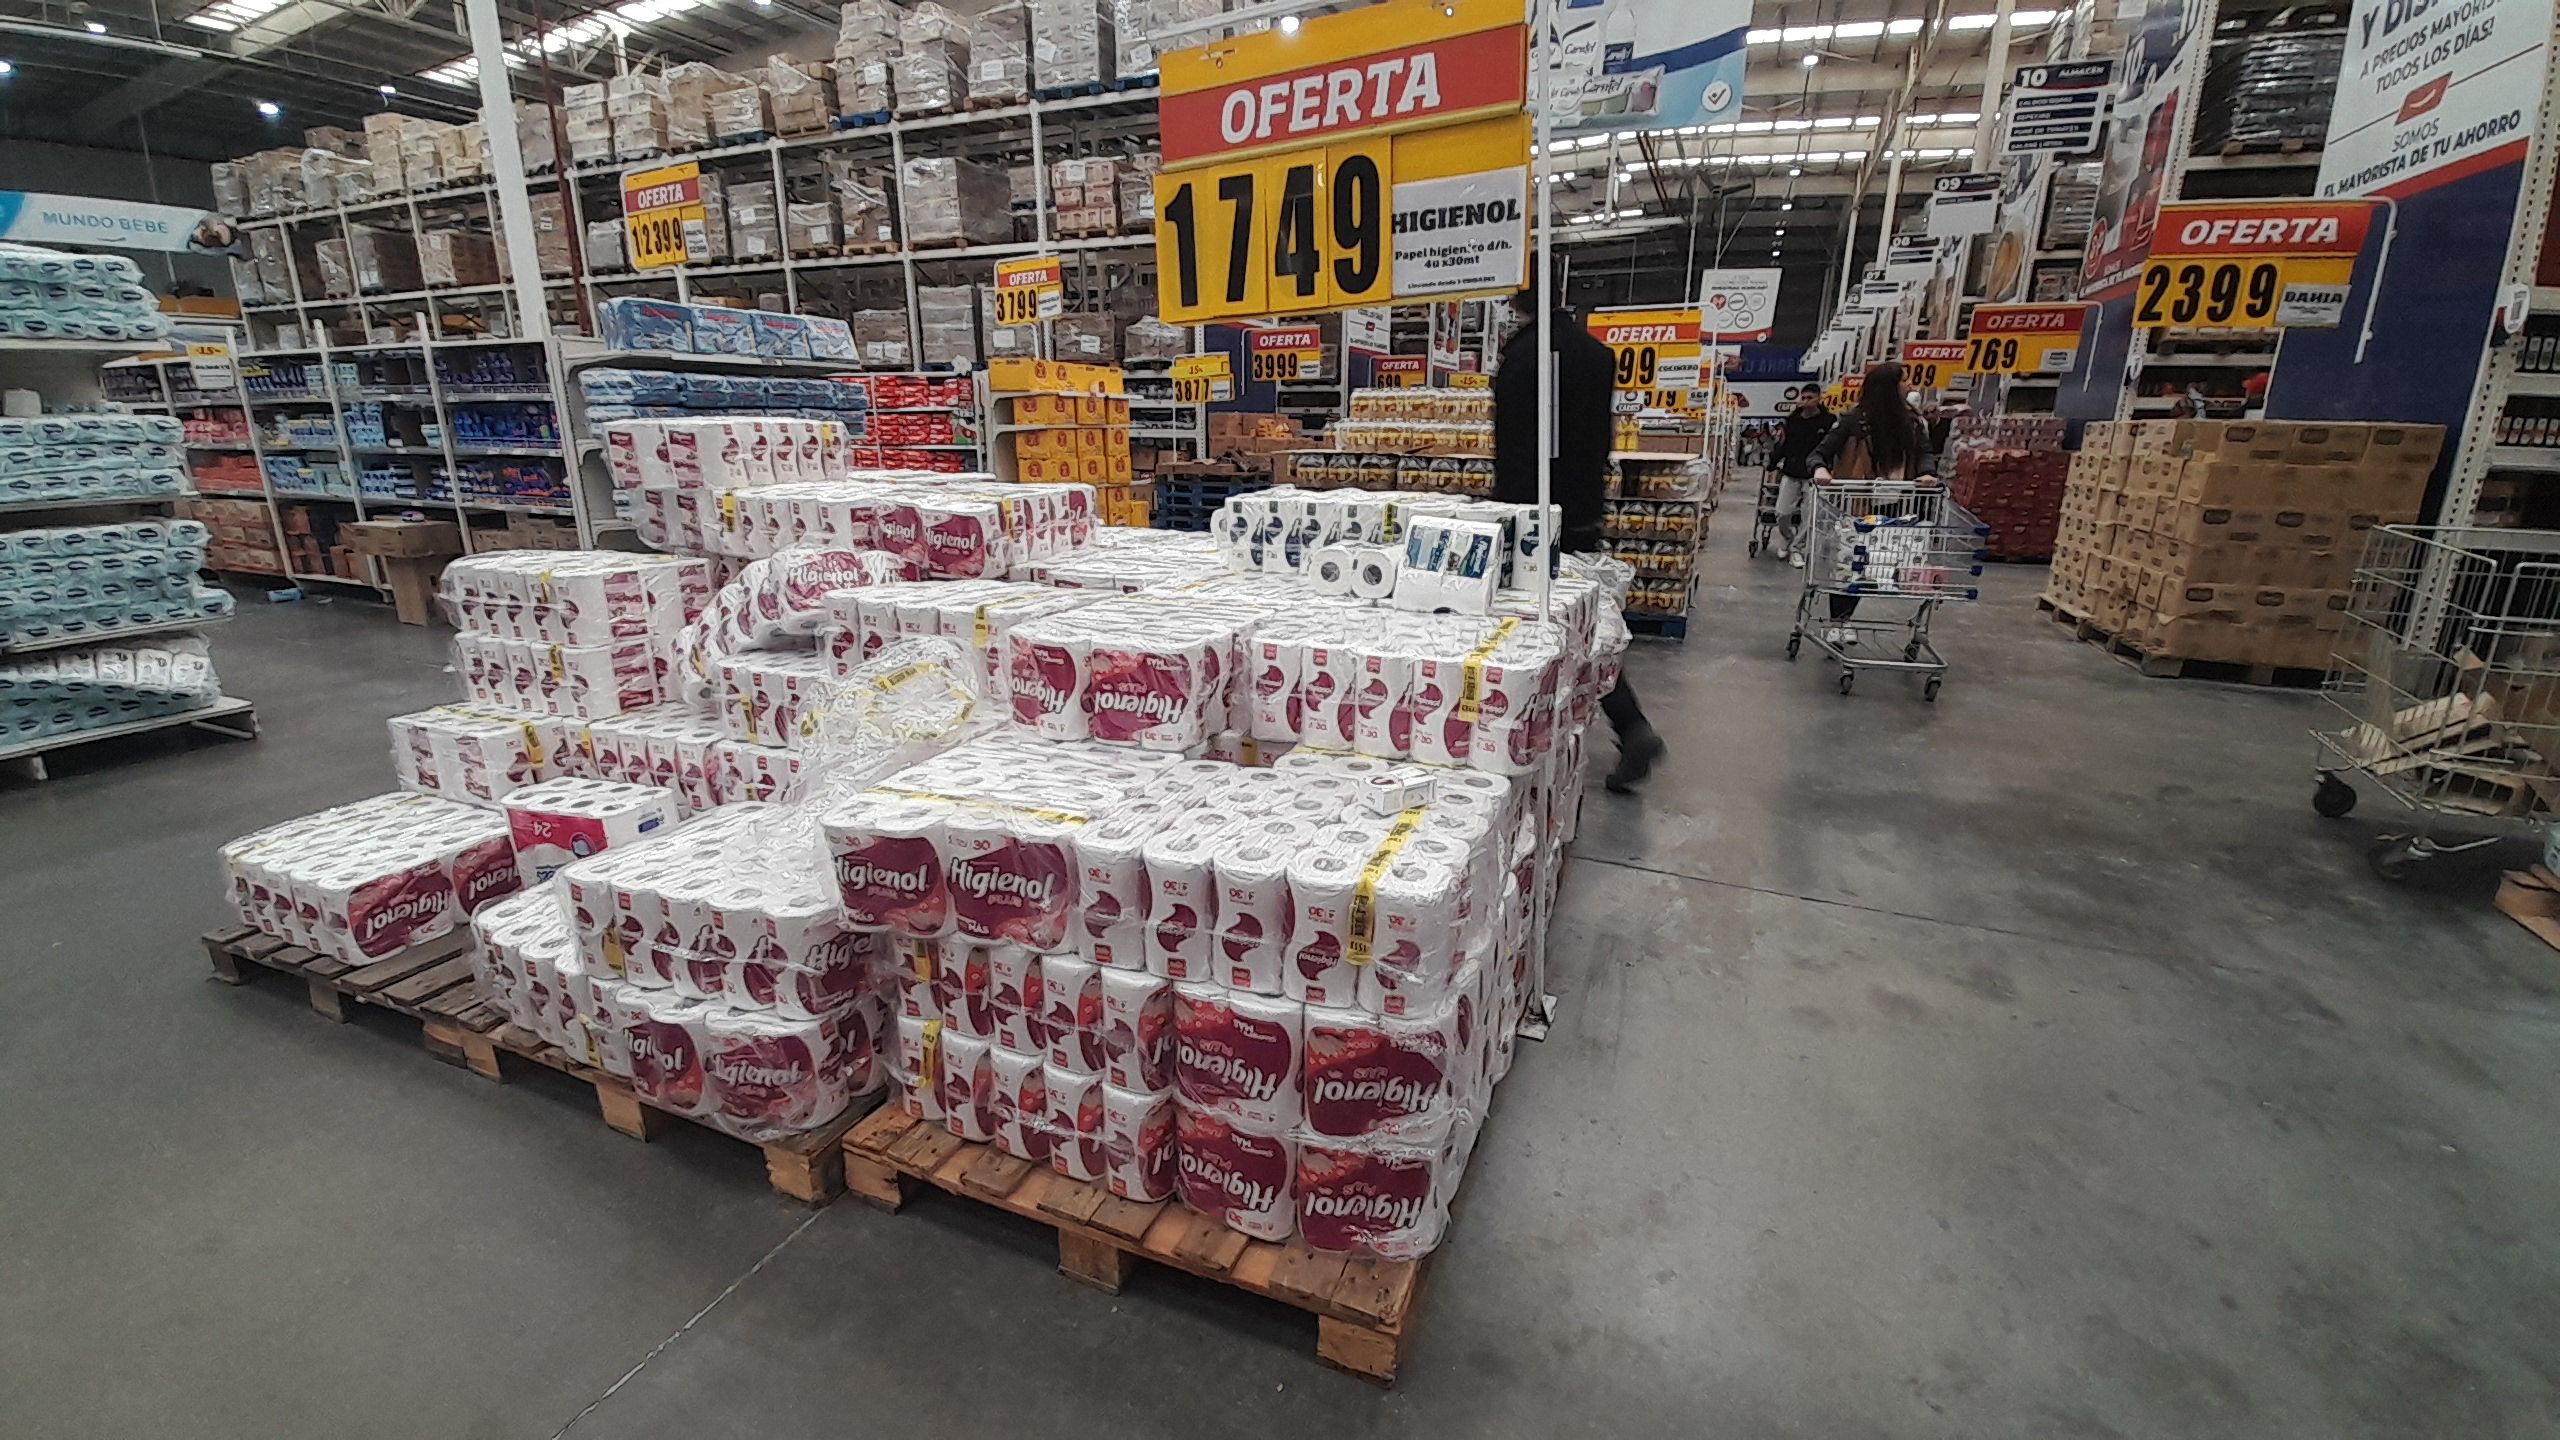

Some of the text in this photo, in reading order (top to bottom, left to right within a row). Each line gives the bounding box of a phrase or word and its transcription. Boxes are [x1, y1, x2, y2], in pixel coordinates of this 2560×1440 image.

[2372, 26, 2428, 73] PRECIOS
[2020, 68, 2048, 88] 10
[2376, 57, 2419, 95] TODOS
[2422, 41, 2451, 71] LOS
[1220, 52, 1441, 144] OFERTA
[2392, 118, 2439, 152] SOMOS
[2337, 157, 2406, 197] MAYORISTA
[2411, 147, 2429, 168] DE
[2433, 135, 2451, 158] TU
[2453, 109, 2521, 151] AHORRO
[637, 183, 684, 209] OFERTA
[42, 211, 114, 229] MUNDO
[1164, 154, 1381, 308] 1749
[1391, 198, 1521, 234] HIGIENOL
[2181, 217, 2339, 246] OFERTA
[632, 217, 683, 258] 12399
[1395, 248, 1427, 261] Papel
[1009, 269, 1048, 286] OFERTA
[2138, 263, 2278, 323] 2399
[996, 289, 1037, 321] 3799
[1987, 313, 2065, 328] OFERTA
[1259, 334, 1311, 347] OFERTA
[1607, 326, 1676, 342] OFERTA
[1255, 353, 1298, 379] 3999
[1381, 361, 1420, 370] OFERTA
[1968, 338, 2019, 371] 769
[1175, 378, 1210, 401] 3877
[1095, 690, 1184, 724] Higienol
[972, 839, 990, 851] 30
[951, 857, 1056, 901] Higienol
[366, 889, 450, 939] Higienol
[1314, 1076, 1434, 1113] Higienol
[1304, 1191, 1424, 1229] Higienol
